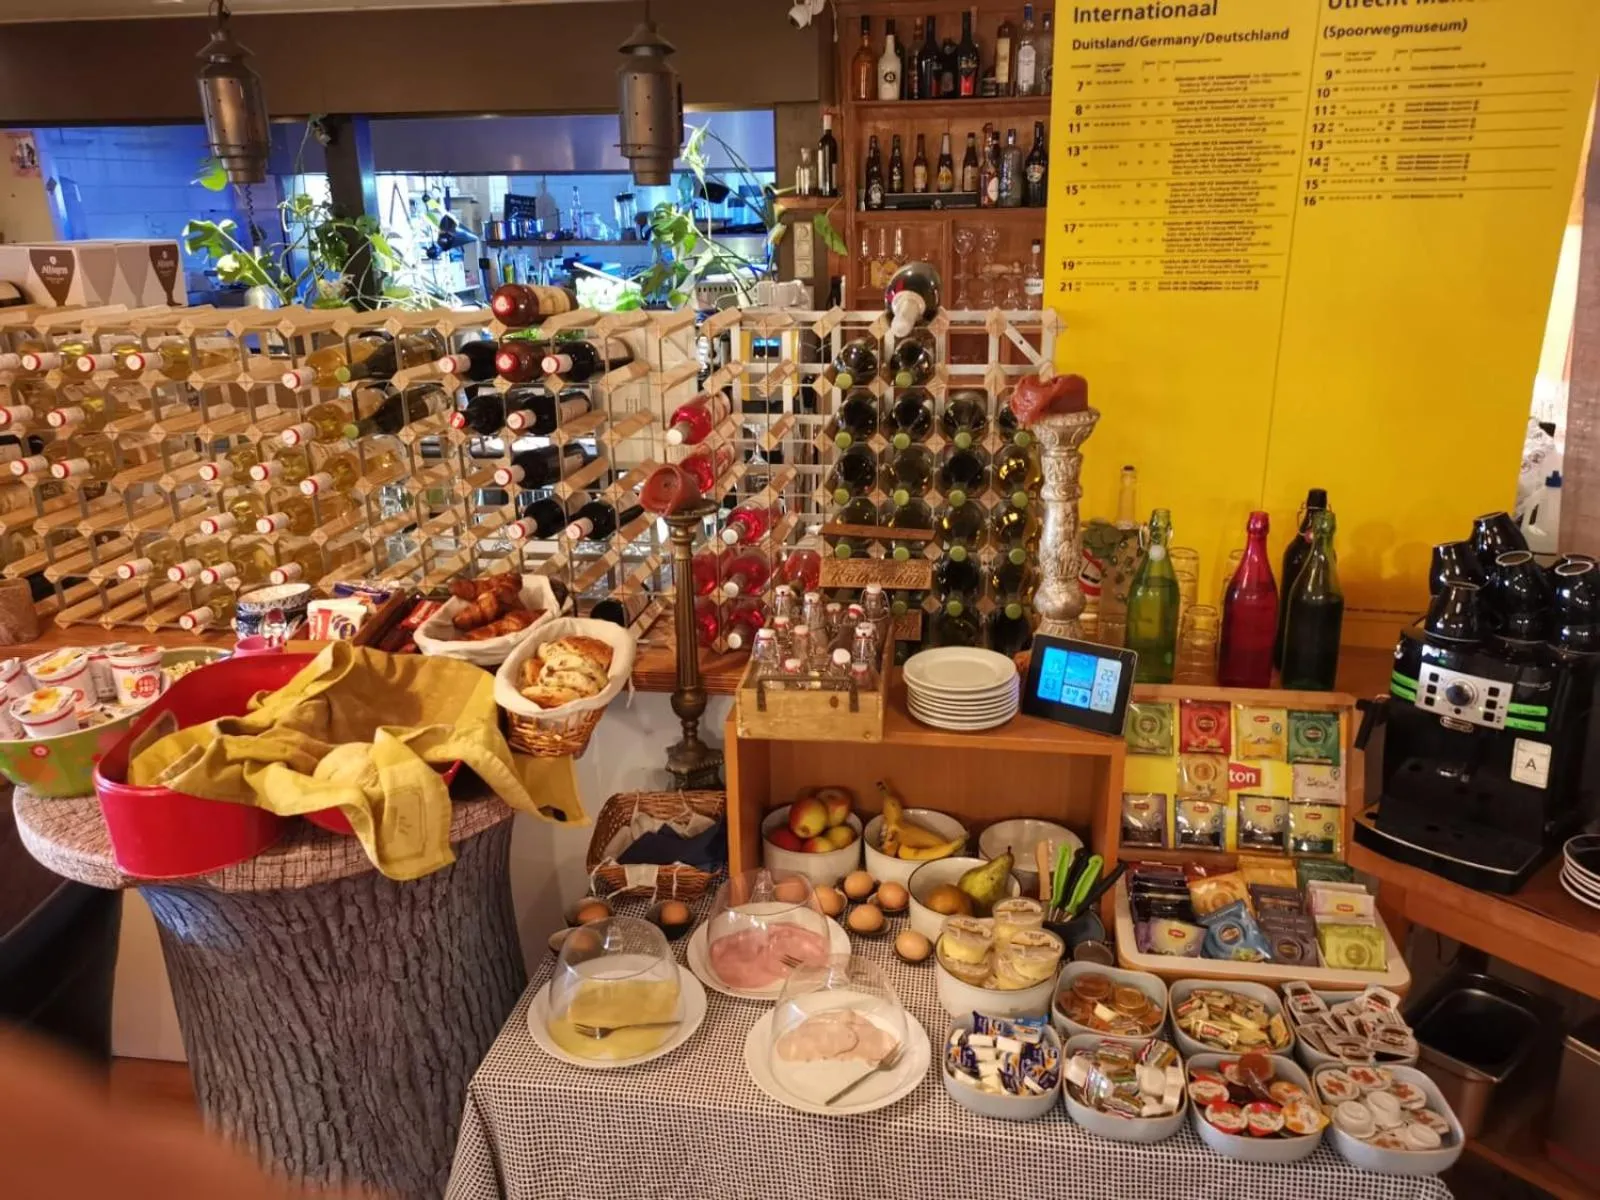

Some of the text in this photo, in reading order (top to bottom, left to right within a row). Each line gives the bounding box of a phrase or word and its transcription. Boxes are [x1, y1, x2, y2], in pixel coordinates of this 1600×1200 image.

[1073, 0, 1218, 24] Internationaal
[1322, 18, 1468, 40] (Spoorwegmuseum)
[1072, 28, 1290, 51] Duitsland/Germany/Deutschland
[1325, 69, 1333, 80] 9
[1076, 81, 1084, 92] 7
[1316, 88, 1331, 98] 10
[1075, 105, 1083, 116] 8
[1314, 105, 1328, 115] 11
[1068, 123, 1081, 133] 11
[1312, 123, 1326, 134] 12
[1310, 140, 1324, 150] 13
[1067, 146, 1081, 157] 13
[1308, 157, 1322, 167] 14
[1065, 185, 1078, 195] 15
[1305, 179, 1319, 190] 15
[1303, 196, 1317, 206] 16
[1063, 223, 1077, 233] 17
[1062, 260, 1075, 271] 19
[1060, 281, 1073, 292] 21
[1524, 758, 1537, 771] A
